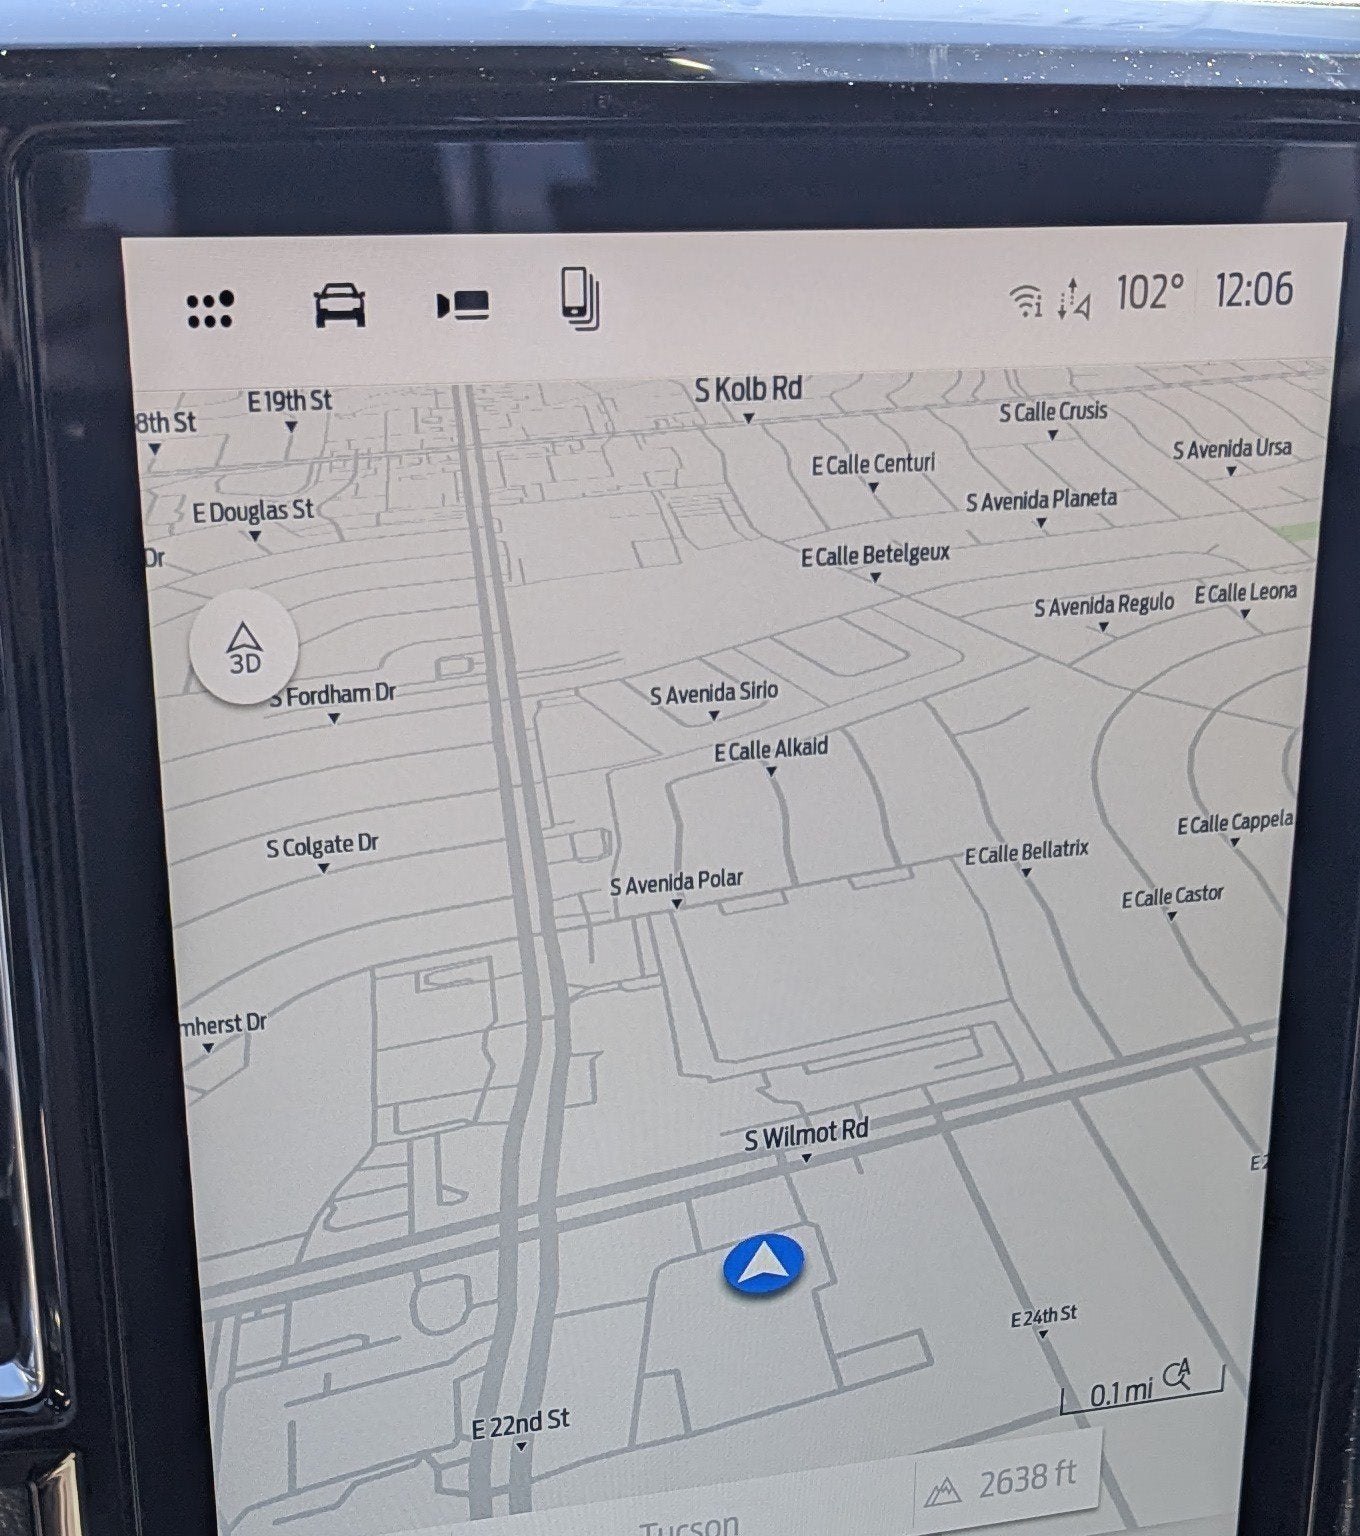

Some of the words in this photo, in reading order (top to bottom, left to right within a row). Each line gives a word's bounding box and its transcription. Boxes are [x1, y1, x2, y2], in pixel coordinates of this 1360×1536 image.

[1118, 273, 1184, 310] 102°
[1216, 271, 1293, 308] 12:06
[248, 391, 260, 412] E
[265, 390, 306, 412] 19th
[311, 389, 333, 411] St
[695, 378, 709, 403] S
[716, 376, 766, 402] Kolb
[772, 374, 802, 400] Rd
[136, 411, 169, 434] 8th
[174, 411, 197, 433] St
[999, 403, 1011, 422] S
[1015, 401, 1056, 422] Calle
[1059, 400, 1108, 421] Crusis
[1173, 441, 1184, 460] S
[1187, 438, 1252, 460] Avenida
[1256, 438, 1292, 457] Ursa
[812, 457, 823, 476] E
[827, 454, 869, 475] Calle
[874, 451, 935, 474] Centuri
[193, 502, 205, 524] E
[210, 499, 288, 526] Douglas
[293, 498, 315, 520] St
[966, 493, 978, 513] S
[981, 489, 1049, 512] Avenida
[1053, 487, 1118, 509] Planeta
[801, 548, 812, 568] E
[816, 545, 859, 566] Calle
[863, 542, 950, 567] Betelgeux
[1034, 599, 1045, 618] S
[1049, 595, 1114, 618] Avenida
[1118, 592, 1175, 616] Regulo
[1195, 586, 1205, 605] E
[1208, 583, 1246, 603] Calle
[1250, 582, 1297, 602] Leona
[230, 653, 261, 675] 3D
[287, 683, 371, 707] Fordham
[376, 681, 396, 702] Dr
[650, 686, 661, 706] S
[666, 682, 736, 705] Avenida
[740, 680, 779, 700] Sirio
[715, 744, 726, 763] E
[729, 740, 771, 761] Calle
[775, 736, 829, 760] Alkaid
[1178, 817, 1188, 836] E
[1190, 814, 1228, 834] Calle
[1231, 809, 1294, 834] Cappela
[267, 840, 279, 859] S
[283, 835, 353, 860] Colgate
[358, 832, 379, 852] Dr
[965, 847, 976, 866] E
[979, 844, 1018, 864] Calle
[1022, 838, 1089, 862] Bellatrix
[610, 877, 621, 896] S
[625, 872, 694, 895] Avenida
[698, 867, 743, 889] Polar
[1122, 891, 1132, 909] E
[1135, 888, 1172, 908] Calle
[1176, 884, 1224, 905] Castor
[247, 1012, 267, 1032] Dr
[745, 1130, 758, 1152] S
[763, 1122, 837, 1150] Wilmot
[842, 1116, 869, 1140] Rd
[1251, 1155, 1259, 1171] E
[1011, 1312, 1020, 1328] E
[1024, 1307, 1058, 1327] 24th
[1061, 1304, 1078, 1322] St
[1091, 1380, 1118, 1407] 0.1
[1126, 1376, 1153, 1403] mi
[472, 1419, 485, 1440] E
[490, 1410, 542, 1438] 22nd
[547, 1407, 571, 1431] St
[979, 1462, 1048, 1499] 2638
[1055, 1458, 1077, 1487] ft
